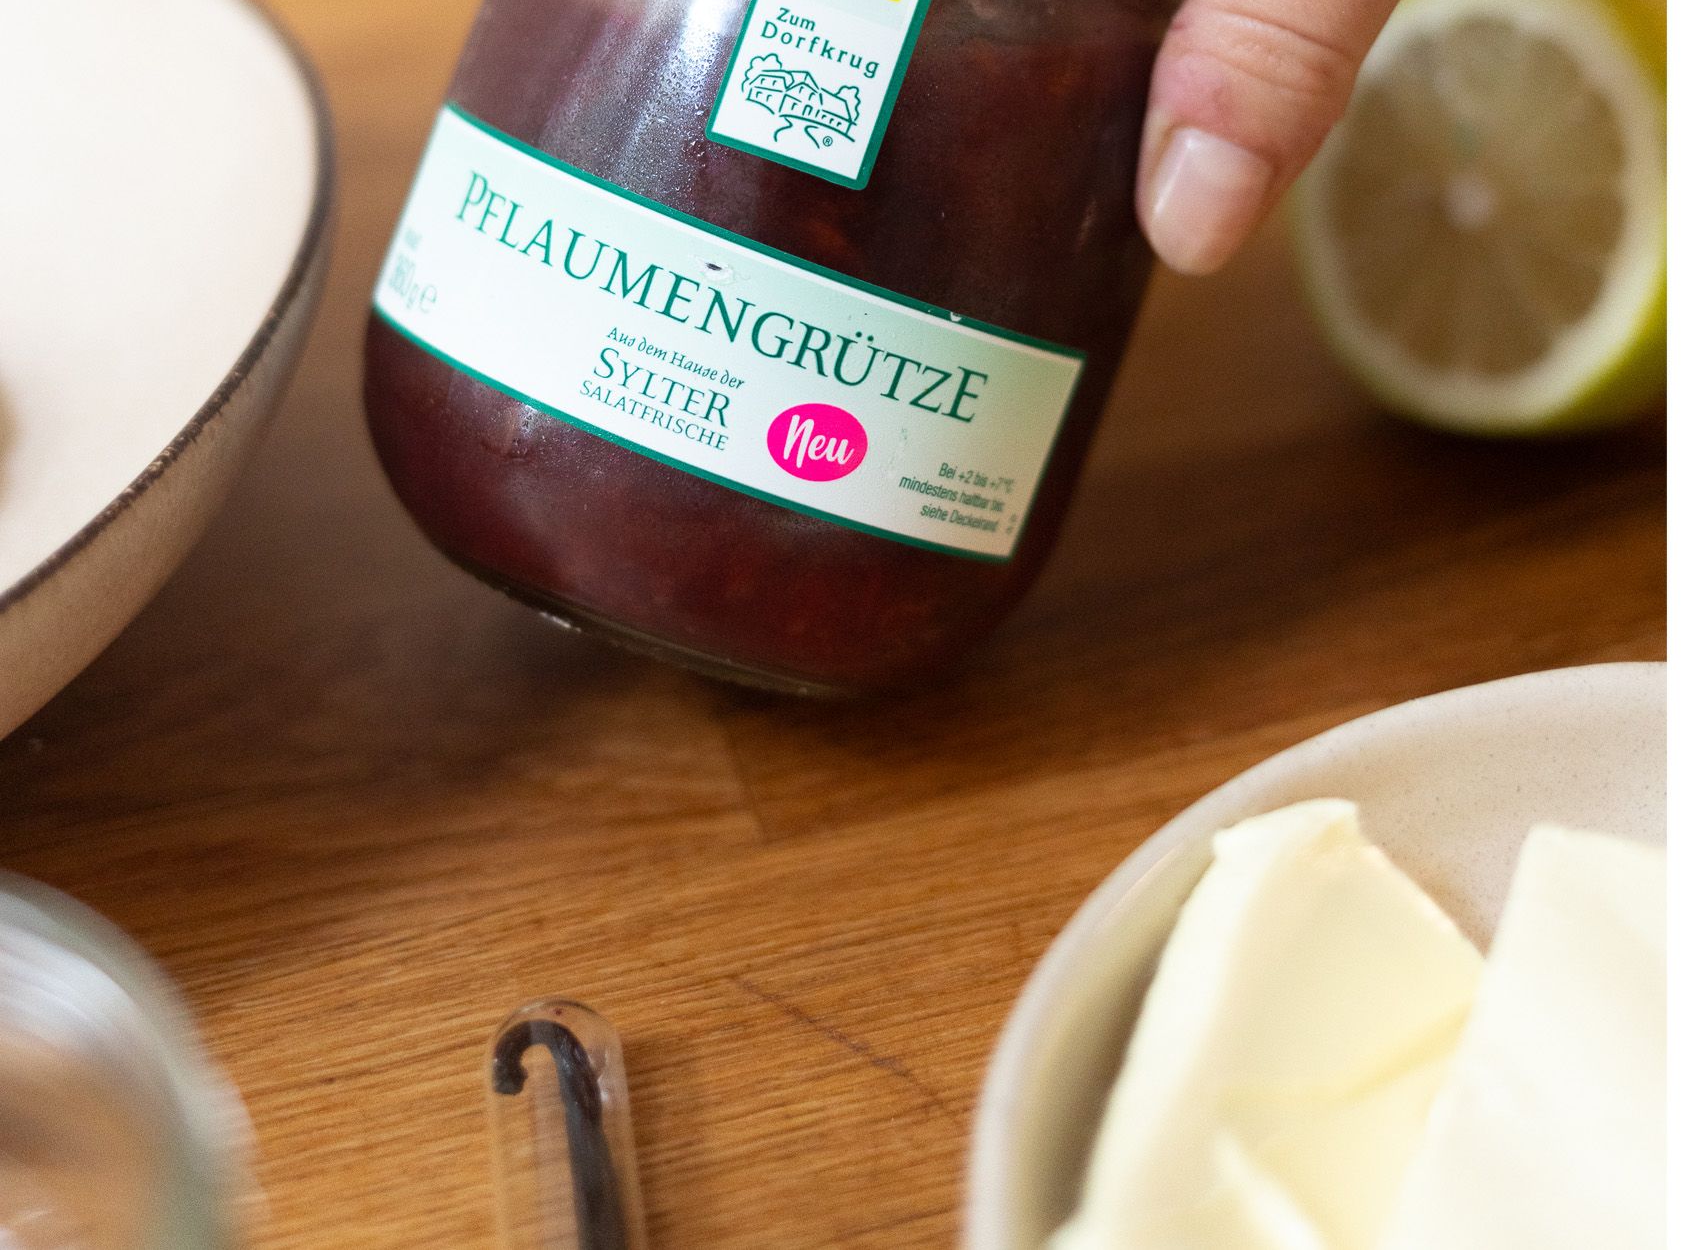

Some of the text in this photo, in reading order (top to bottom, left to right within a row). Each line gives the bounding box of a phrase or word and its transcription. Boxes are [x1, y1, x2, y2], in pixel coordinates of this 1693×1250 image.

[776, 7, 817, 32] Zum
[759, 20, 881, 80] Dorfkrug
[455, 170, 987, 423] PFLAUMENGRÜTZE
[606, 326, 746, 390] Aus dem Hause der
[580, 379, 729, 452] SALATFRISCHE
[782, 413, 855, 470] Neu
[898, 475, 959, 503] mindestens
[938, 461, 958, 480] Bei
[957, 469, 974, 485] +2
[920, 502, 949, 521] siehe
